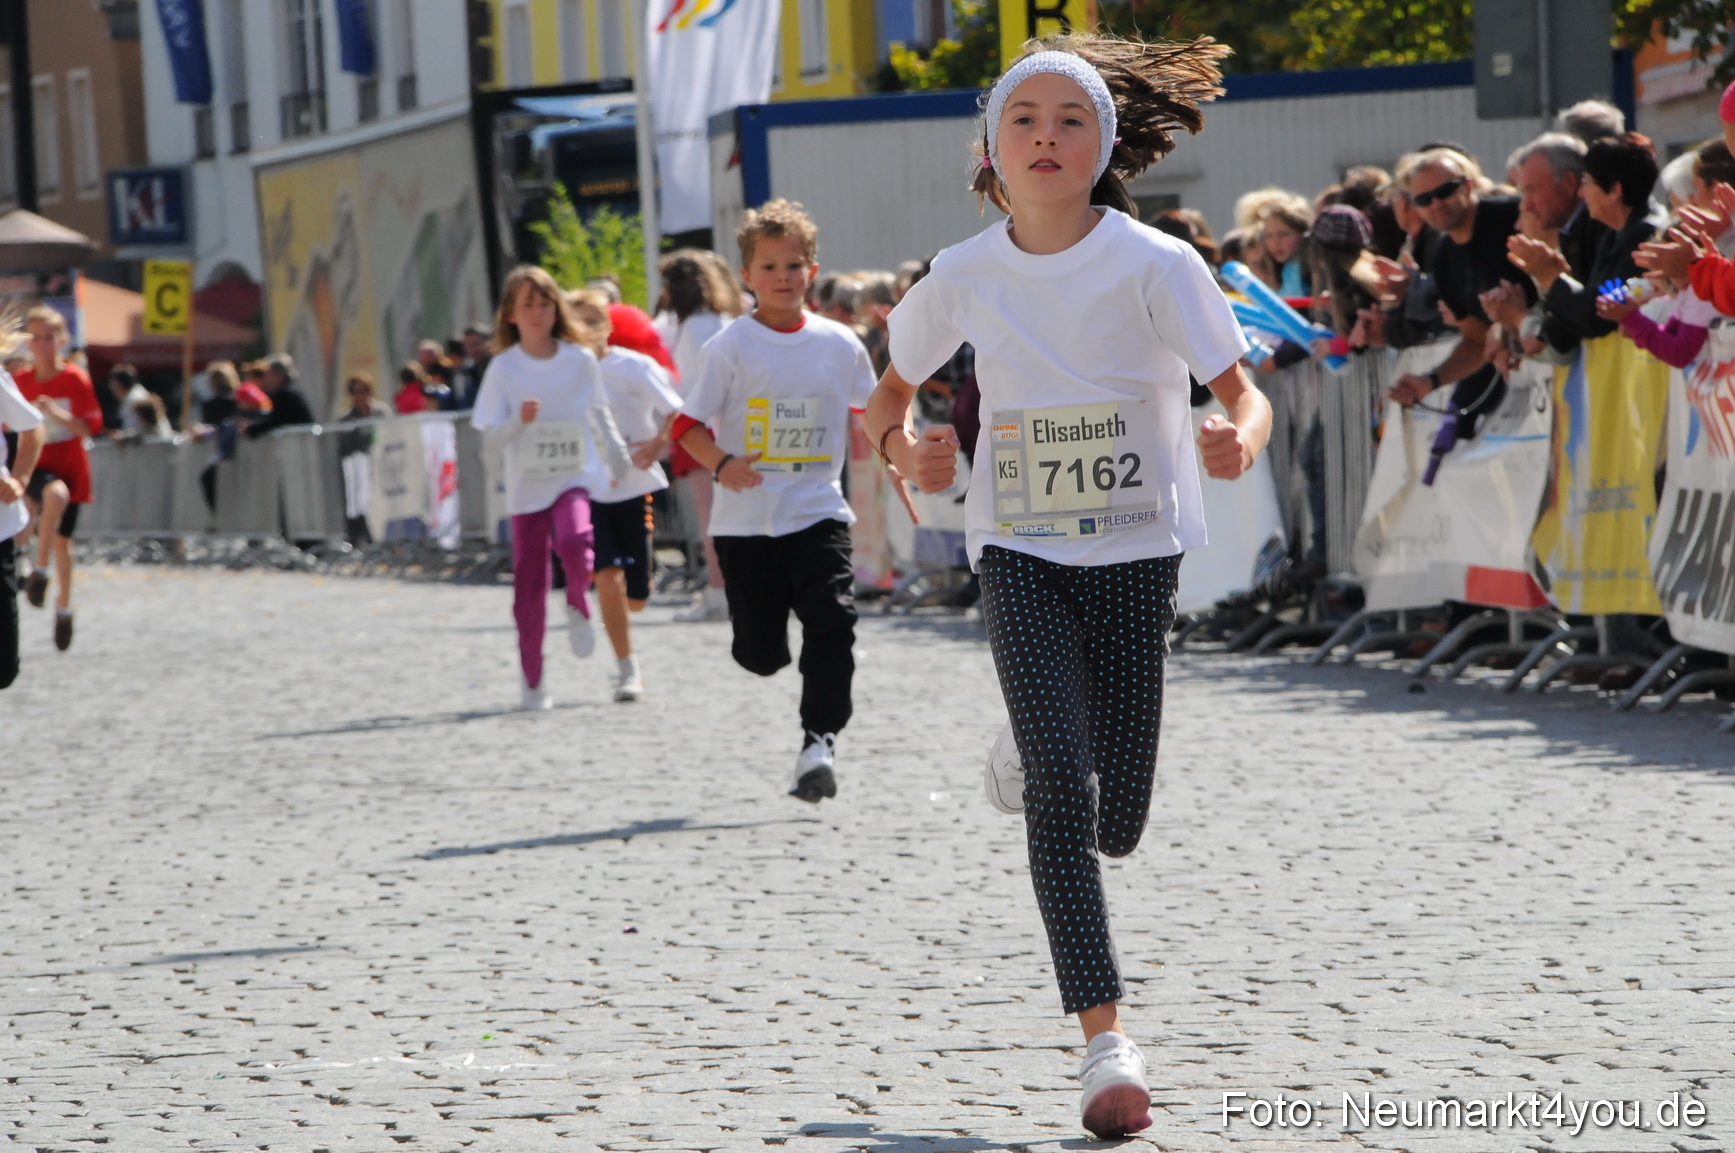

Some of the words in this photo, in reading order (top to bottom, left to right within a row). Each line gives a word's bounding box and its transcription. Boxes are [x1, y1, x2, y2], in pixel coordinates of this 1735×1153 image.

[155, 282, 180, 318] C
[776, 402, 807, 419] Paul
[773, 427, 827, 448] 7277
[1033, 413, 1127, 444] Elisabeth
[999, 460, 1018, 480] K5
[1038, 452, 1143, 496] 7162
[1097, 510, 1157, 527] PFLEIDERER
